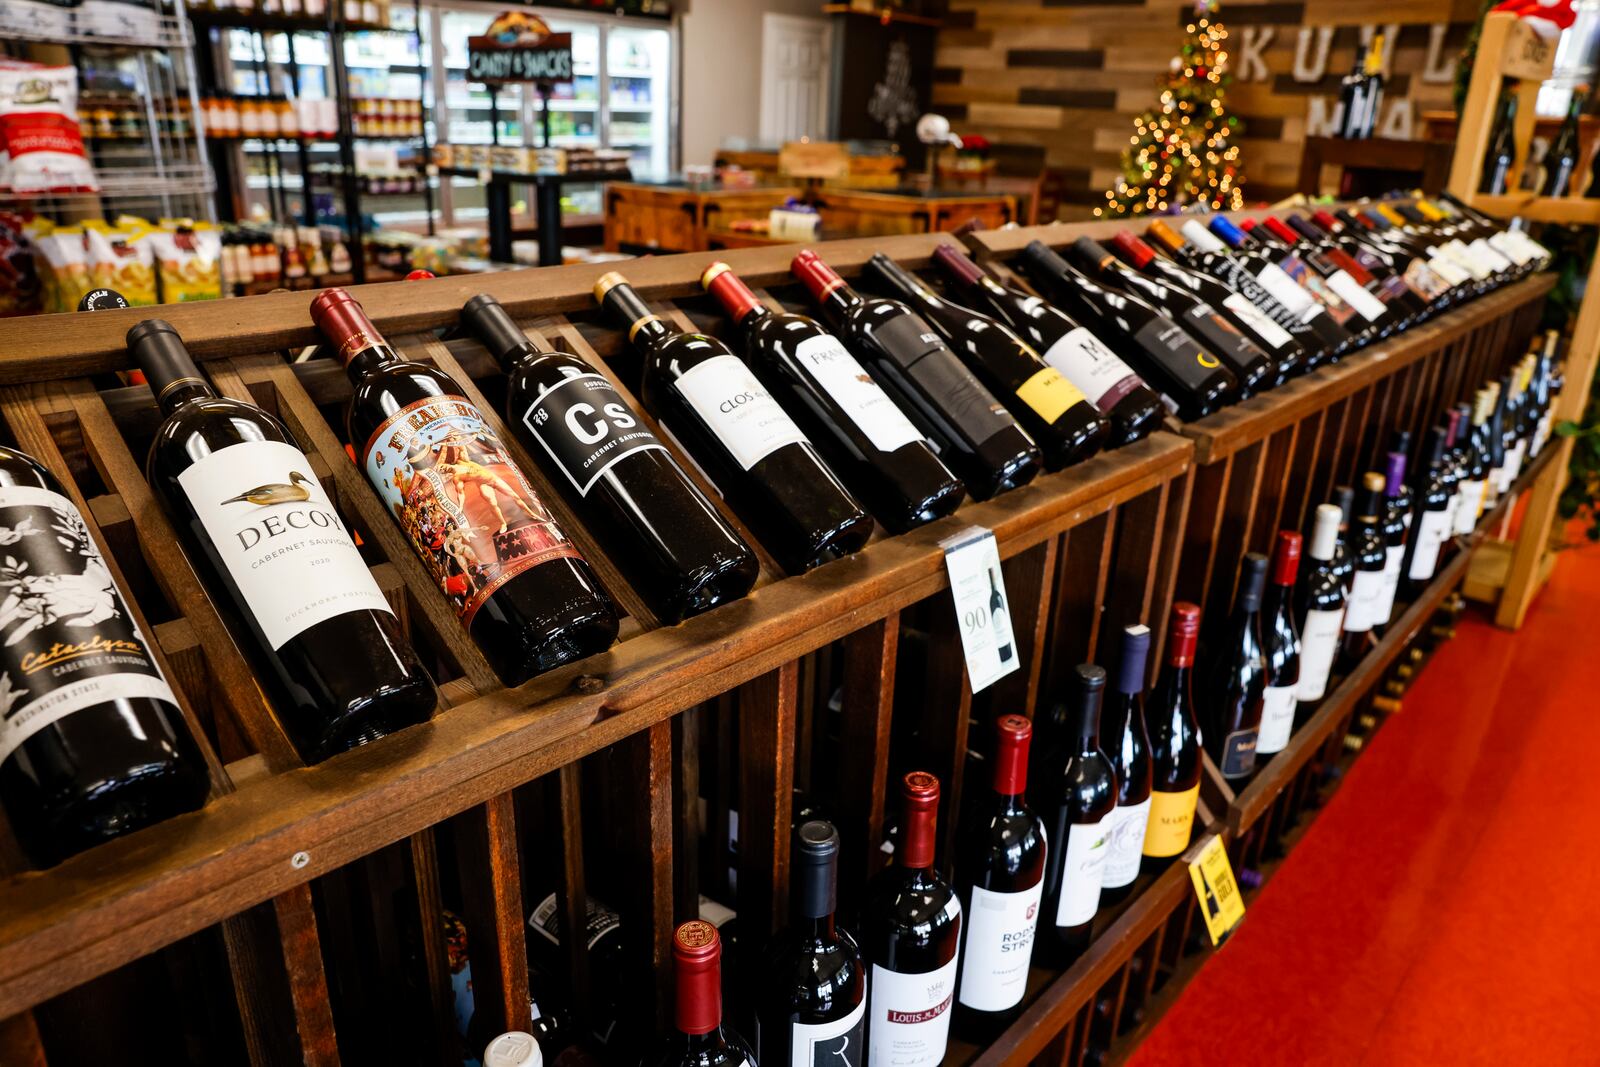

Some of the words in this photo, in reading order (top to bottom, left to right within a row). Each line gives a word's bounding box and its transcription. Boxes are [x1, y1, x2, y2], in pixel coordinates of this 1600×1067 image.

[470, 50, 513, 78] CANDY
[513, 54, 524, 74] &
[523, 49, 571, 79] SNACKS
[533, 408, 544, 422] 20
[719, 391, 754, 414] CLOS
[388, 402, 482, 453] FREAKHO
[565, 402, 636, 445] Cs
[583, 440, 618, 469] CABERNET
[618, 432, 654, 443] SAUVIGNON
[235, 510, 342, 552] DECOY
[251, 541, 305, 569] CABERNET
[310, 557, 331, 566] 2020
[965, 606, 987, 635] 90
[21, 635, 142, 672] Cataclysm
[52, 657, 103, 677] CABERNET
[105, 655, 149, 667] SAUVIGNON
[14, 693, 70, 727] WASHINGTON
[71, 682, 101, 697] STATE
[892, 1011, 922, 1024] LOUIS
